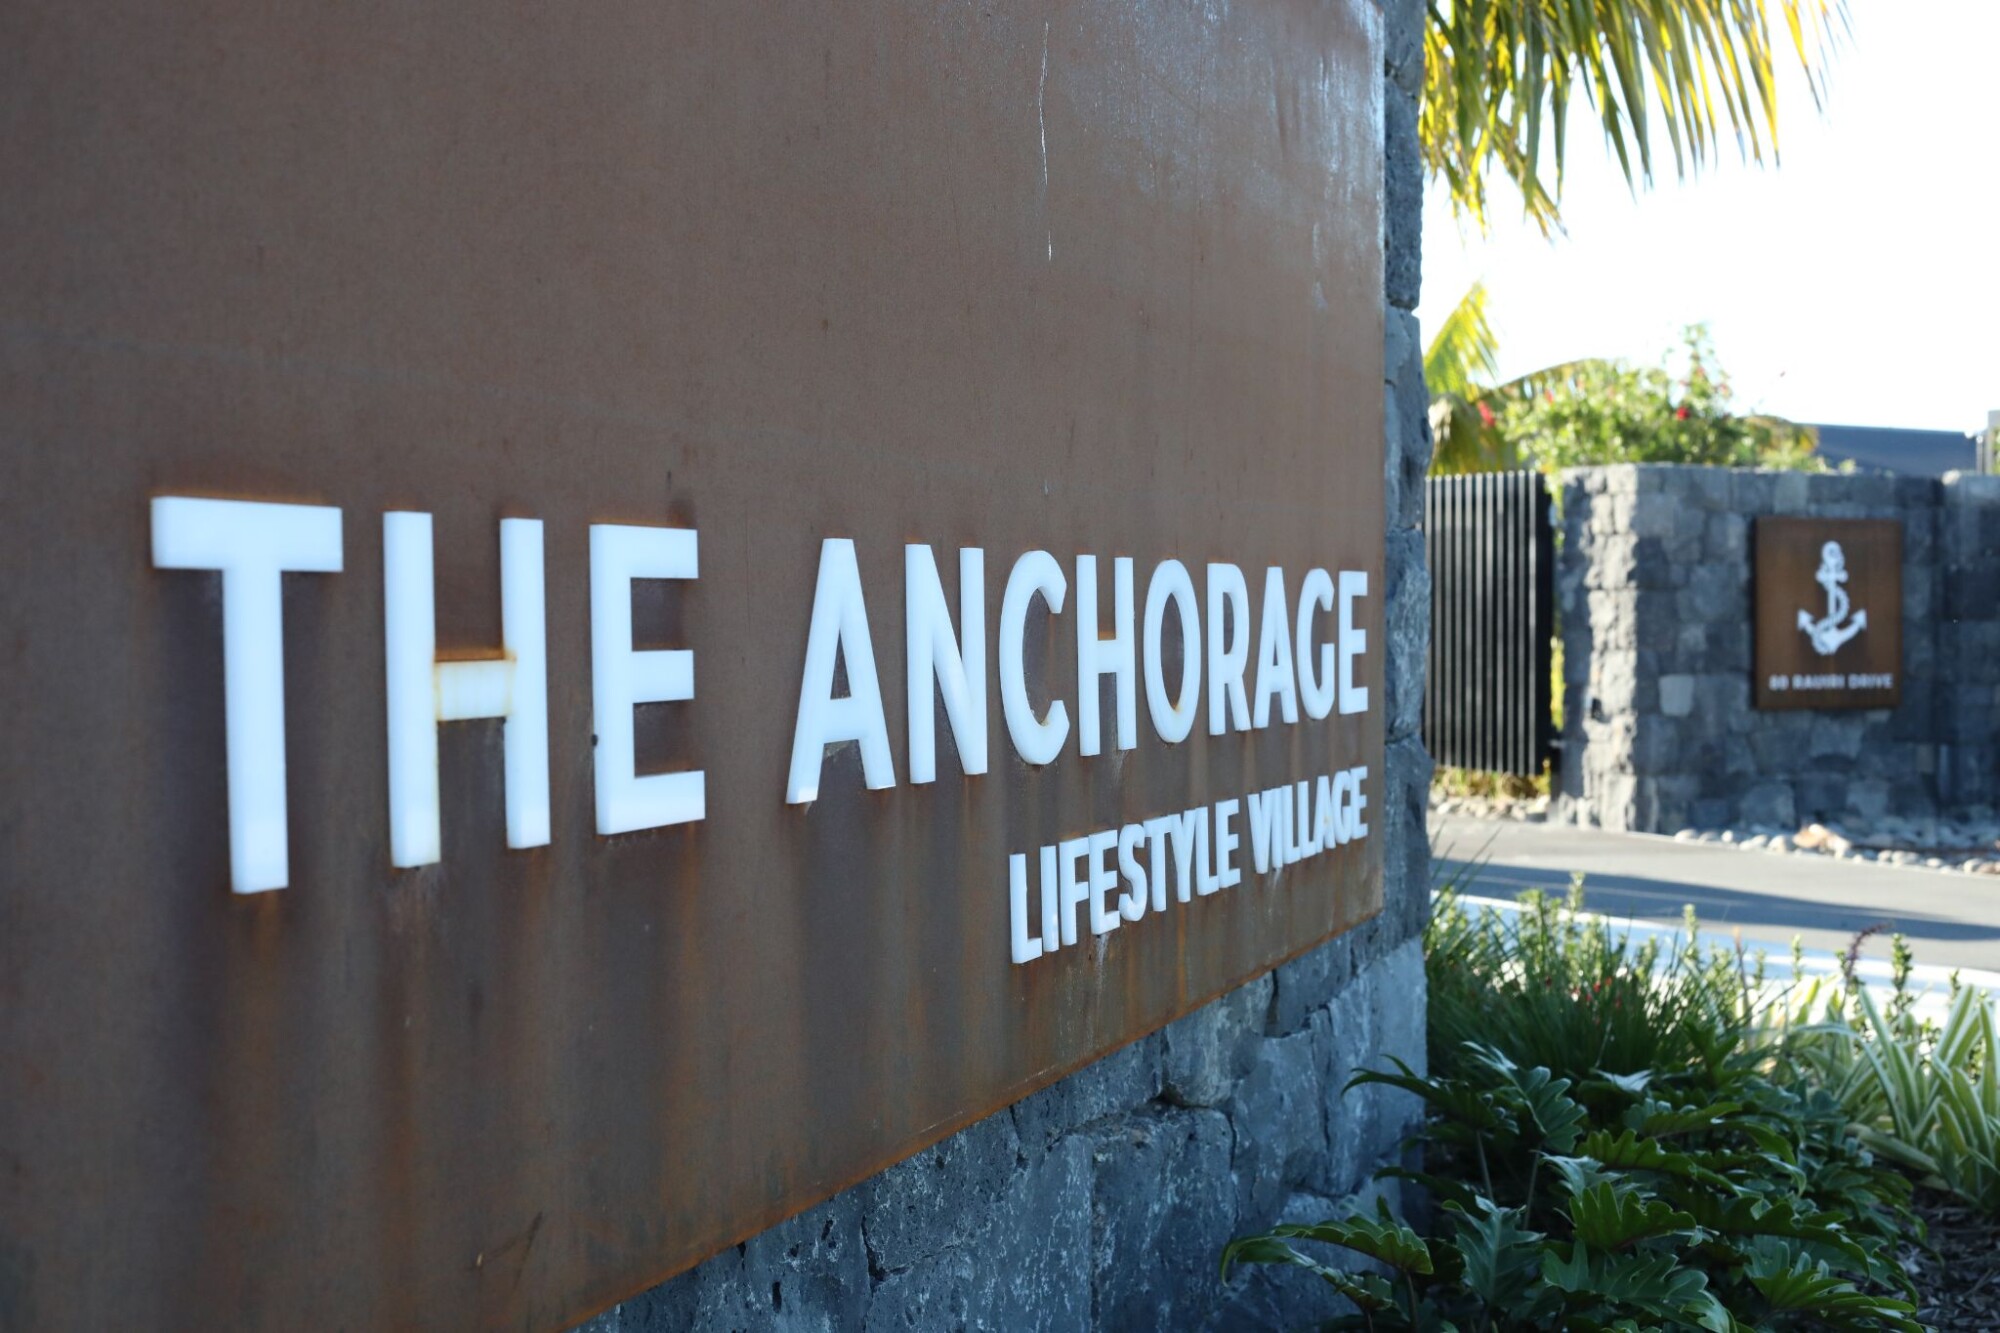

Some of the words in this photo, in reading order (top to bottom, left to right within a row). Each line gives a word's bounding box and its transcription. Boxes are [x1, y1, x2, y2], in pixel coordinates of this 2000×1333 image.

[150, 495, 706, 895] THE
[785, 537, 1369, 805] ANCHORAGE
[1848, 672, 1894, 689] DRIVE
[1009, 798, 1242, 965] LIFESTYLE
[1246, 765, 1369, 875] VILLAGE
